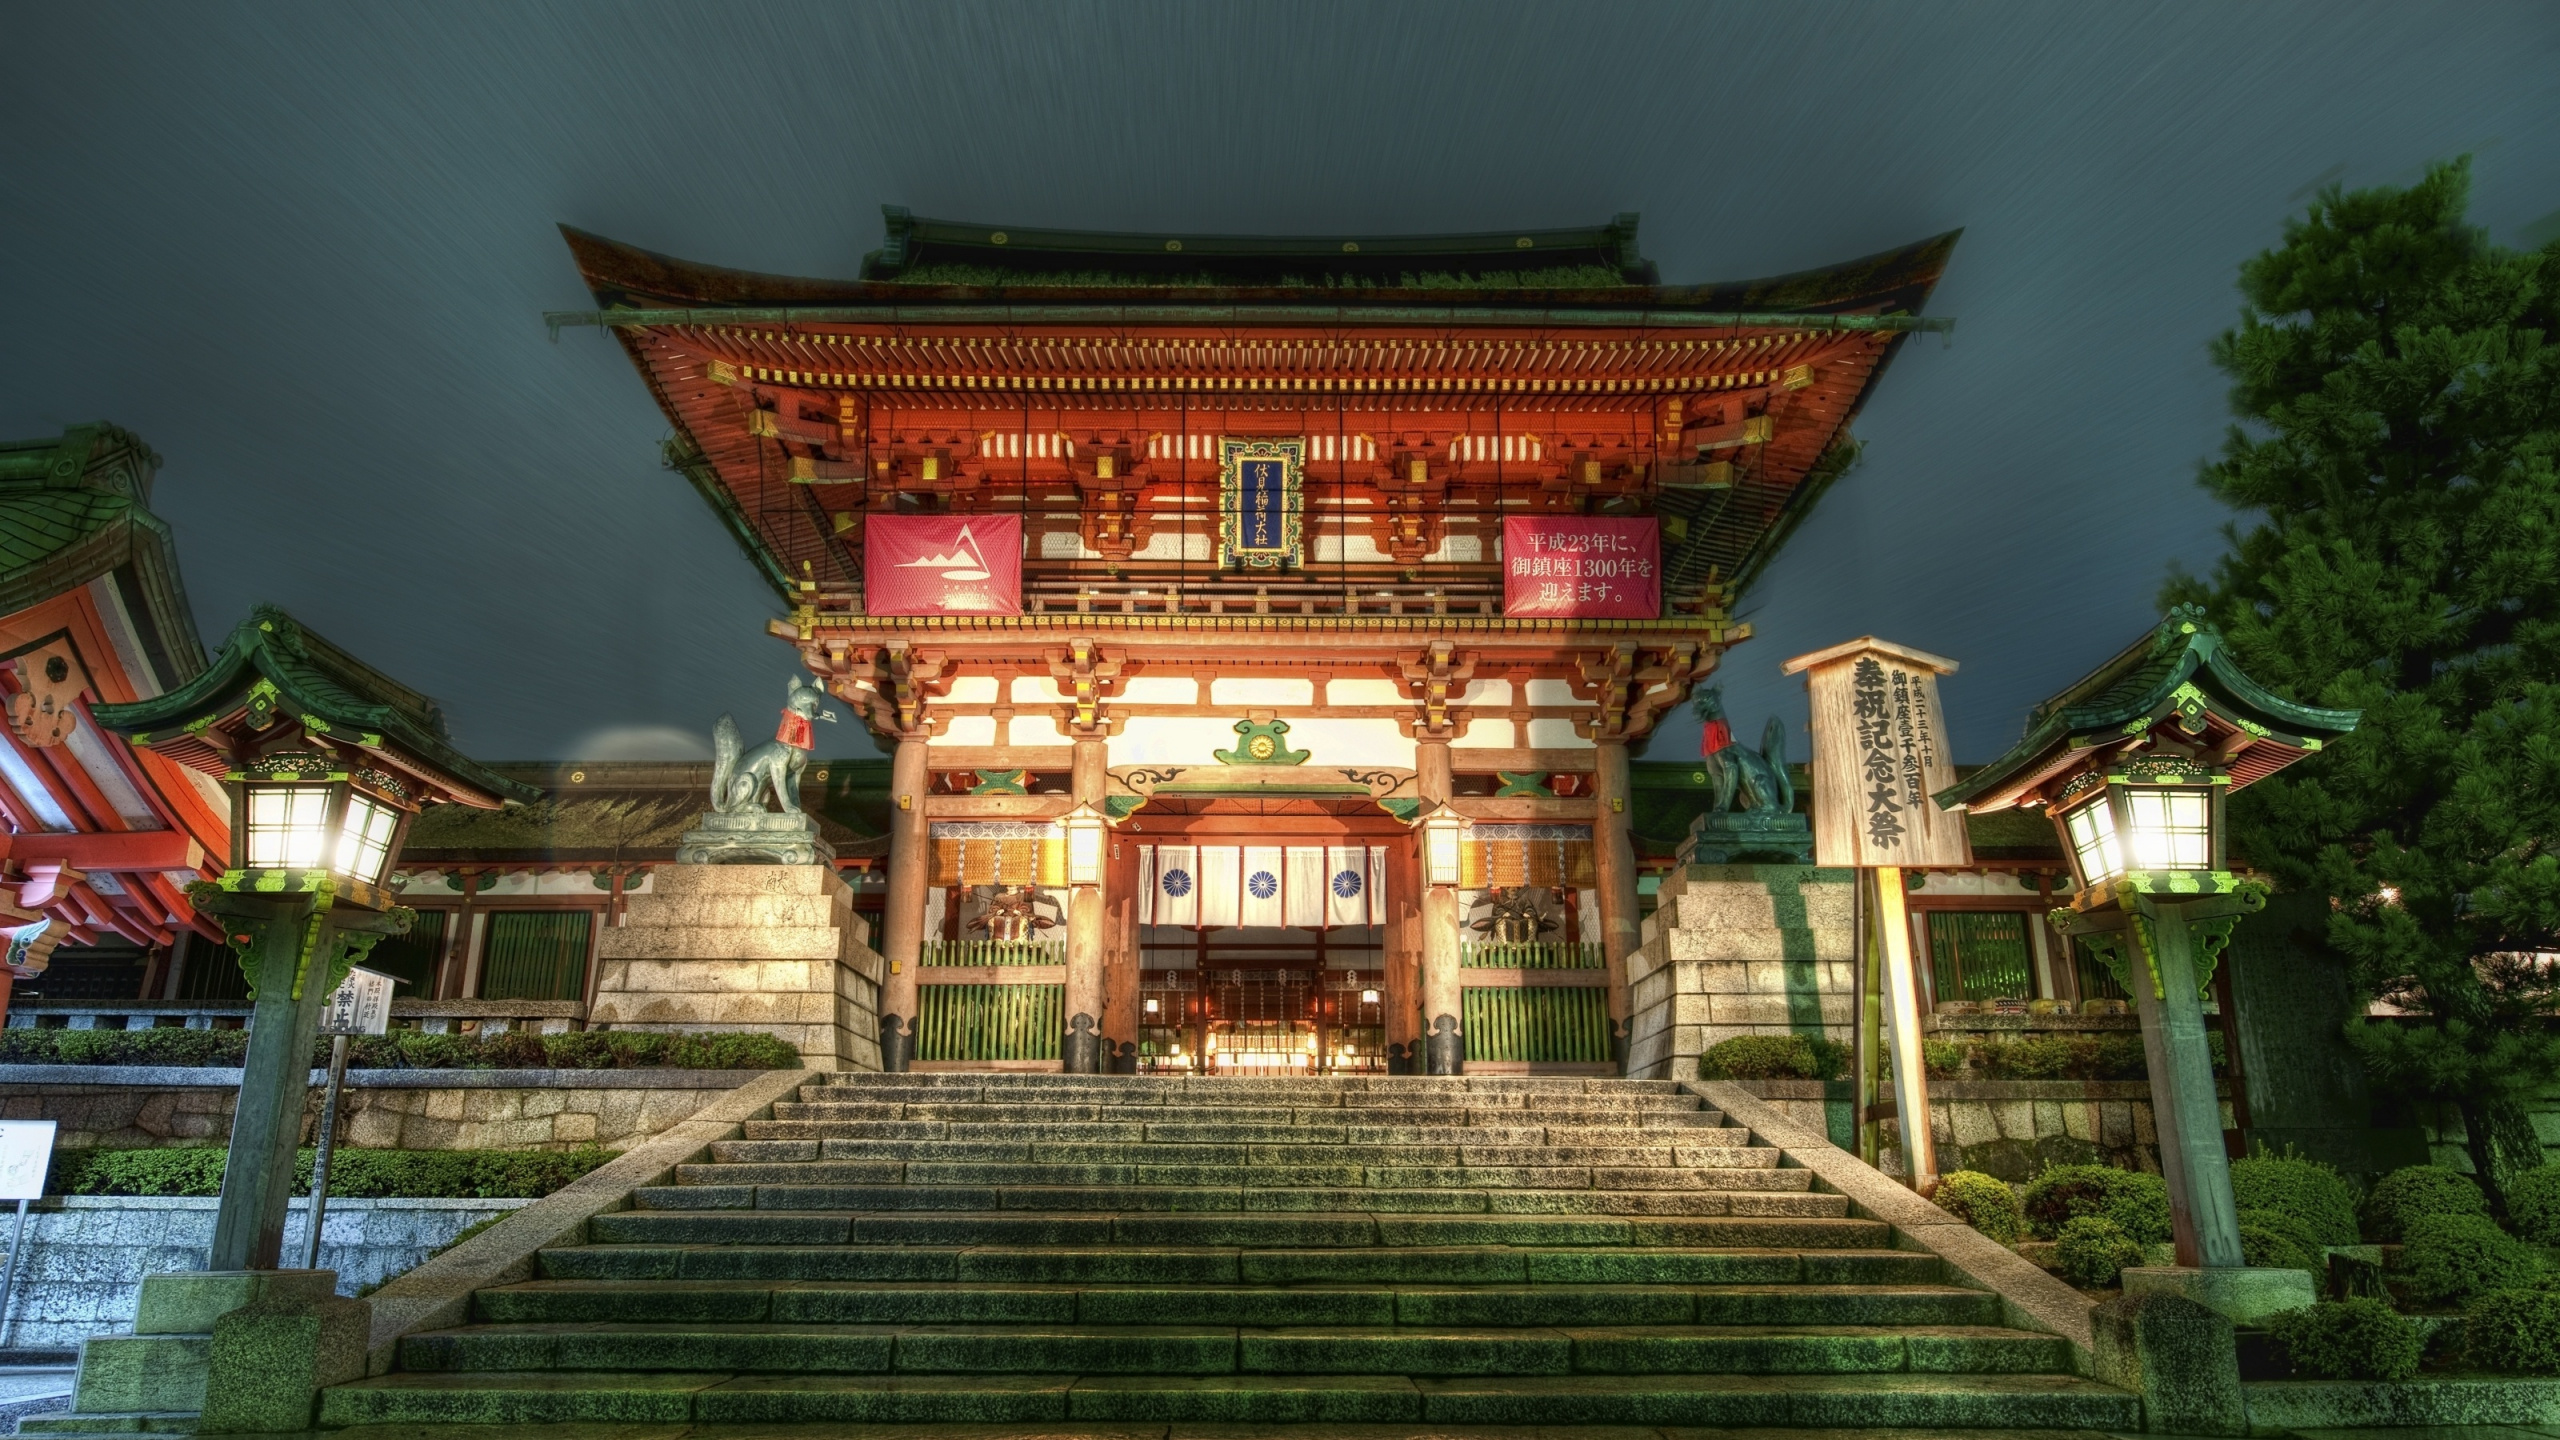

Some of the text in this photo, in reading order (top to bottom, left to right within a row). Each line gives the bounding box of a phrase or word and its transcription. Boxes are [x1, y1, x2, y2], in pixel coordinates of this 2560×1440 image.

[1527, 533, 1636, 553] 平成23年に、
[1511, 557, 1653, 578] 御鎮座1300年を
[1539, 582, 1622, 603] 迎えます。
[1911, 676, 1933, 768] 平成二十三年十月
[1853, 657, 1905, 850] 奉祝記念大祭
